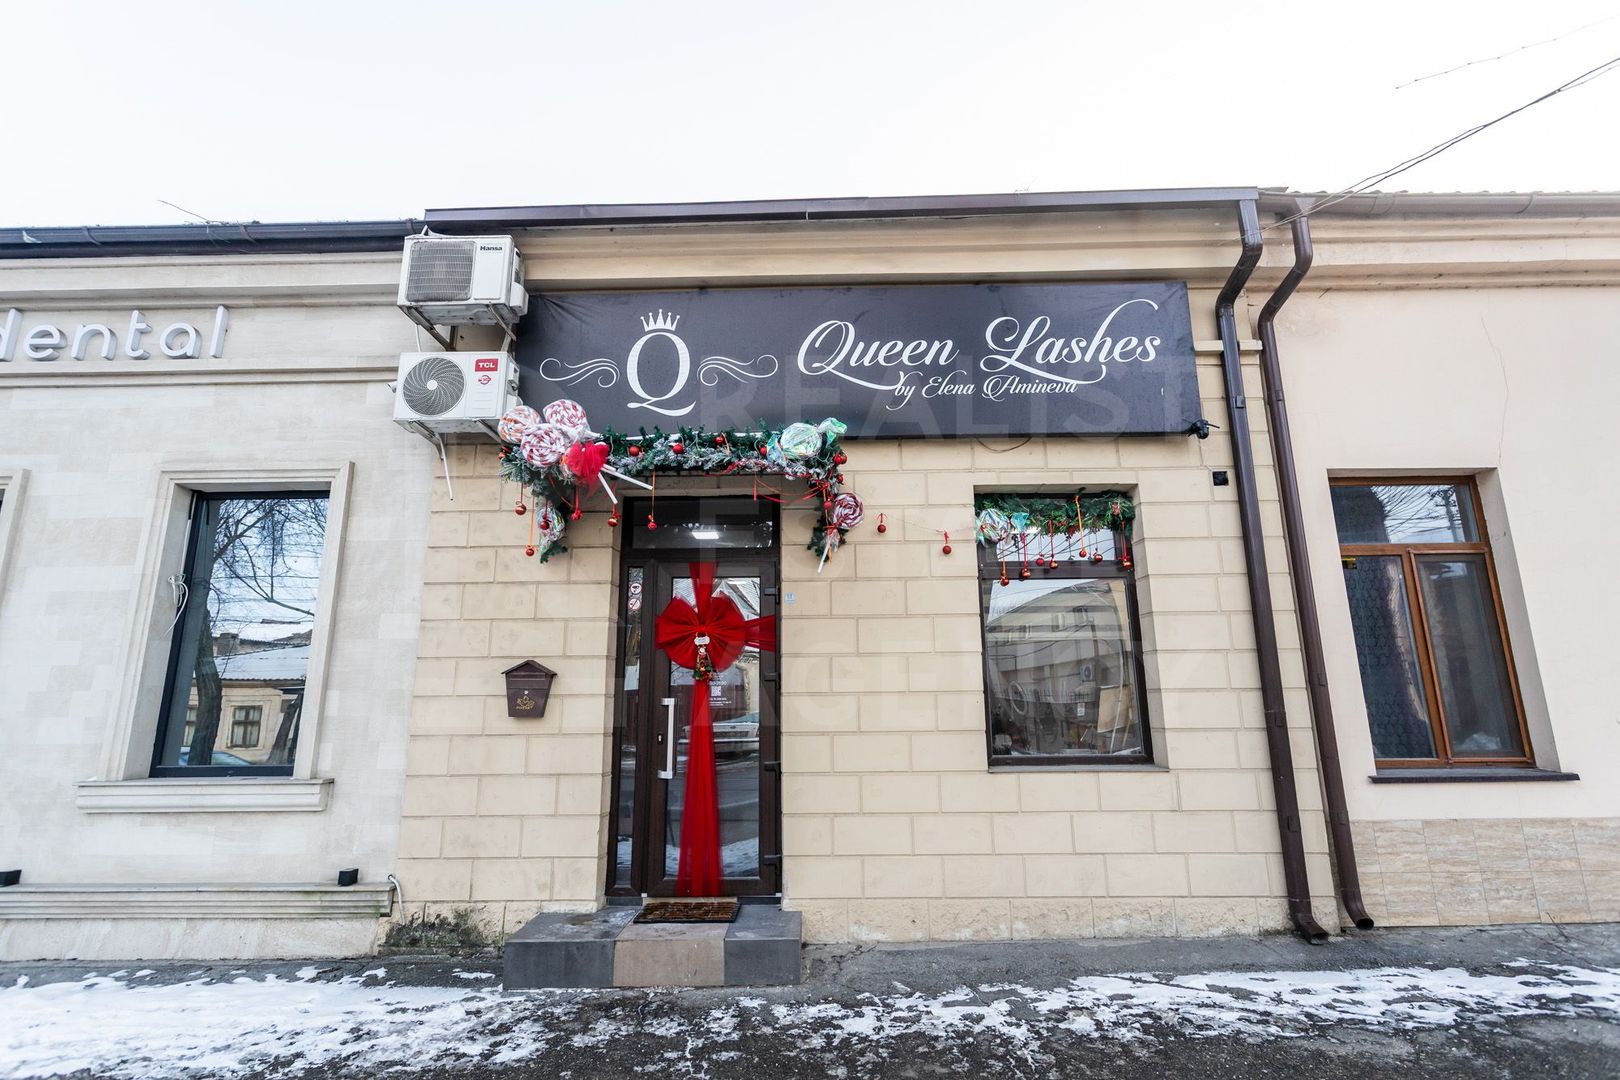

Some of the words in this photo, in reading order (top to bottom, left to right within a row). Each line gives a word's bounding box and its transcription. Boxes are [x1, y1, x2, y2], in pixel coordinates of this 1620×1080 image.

[626, 330, 697, 416] Q
[797, 320, 960, 390] Queen
[979, 299, 1161, 384] Lashes
[886, 371, 923, 410] by
[922, 370, 976, 398] Elena
[981, 375, 1078, 402] Amineva
